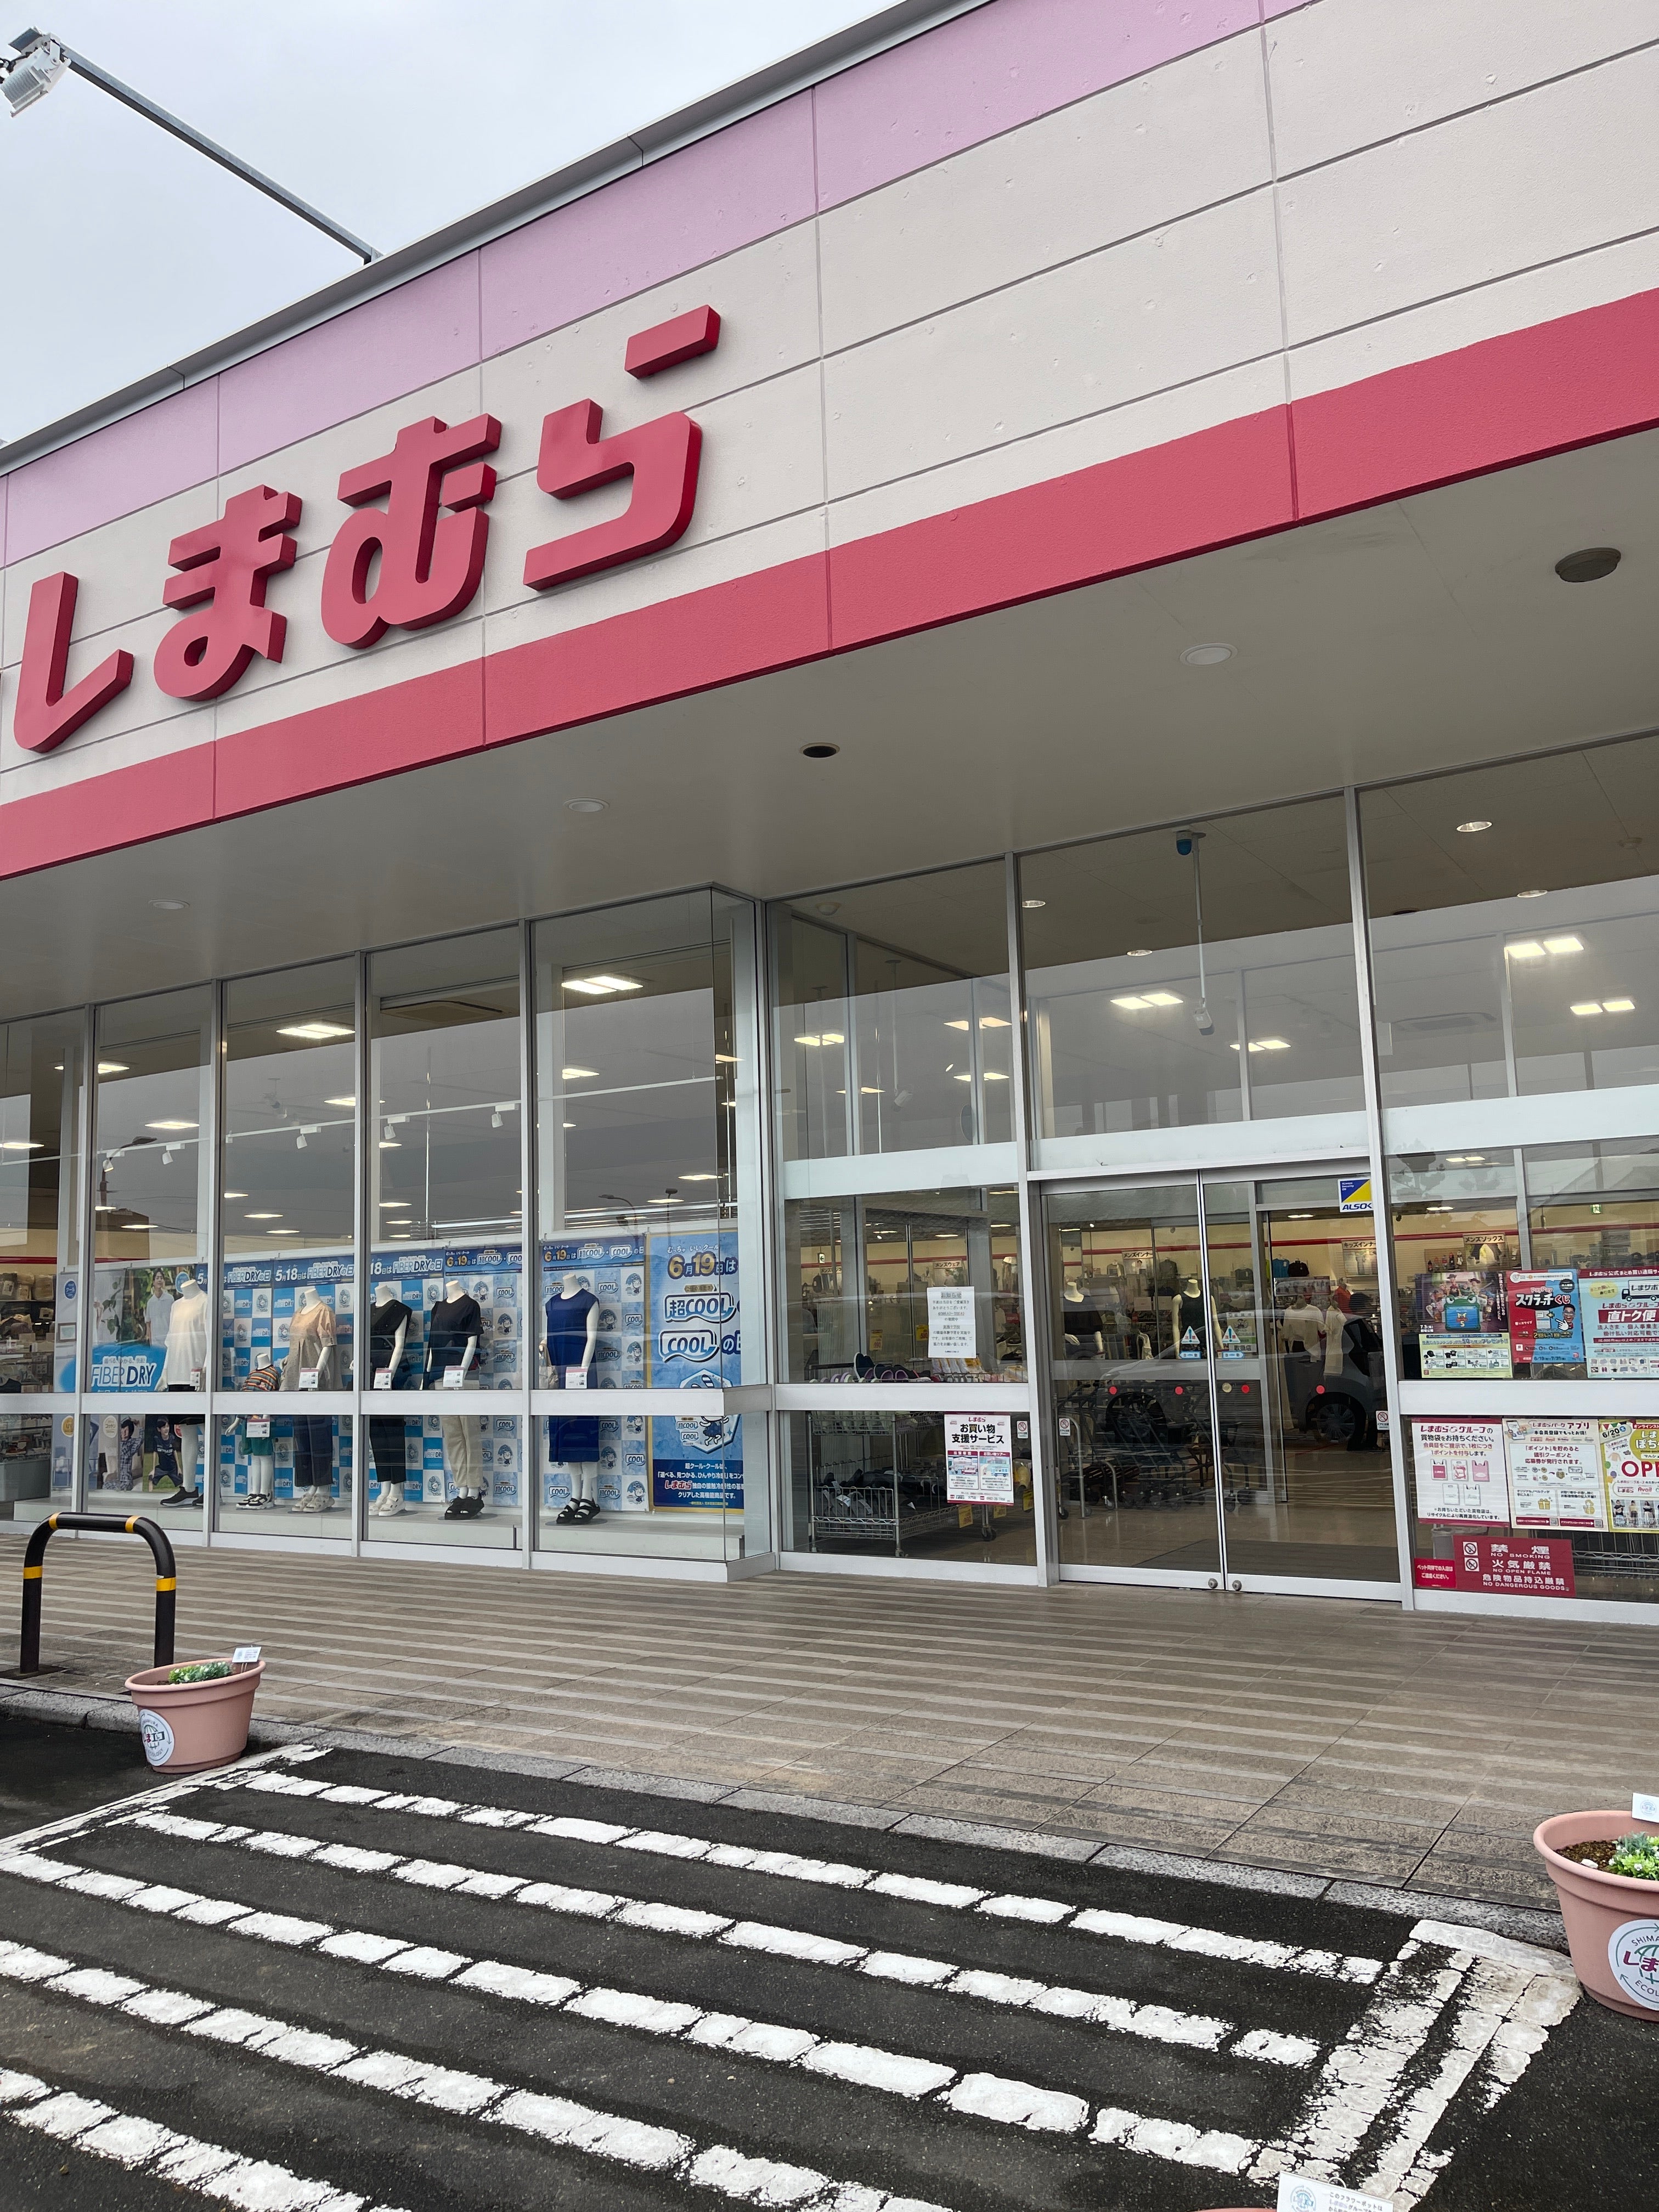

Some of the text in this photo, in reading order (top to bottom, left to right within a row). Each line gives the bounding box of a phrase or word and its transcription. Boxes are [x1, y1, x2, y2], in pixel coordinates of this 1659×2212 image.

[13, 304, 720, 753] しまむら
[446, 1255, 476, 1267] 6月19日は
[544, 1249, 576, 1262] 6月19日は
[668, 1252, 736, 1278] 6月19日は
[1516, 1294, 1571, 1306] スクラッチくじ
[669, 1297, 727, 1317] 超COOL
[1607, 1310, 1657, 1323] 直トク便
[668, 1336, 708, 1353] COOL
[960, 1424, 995, 1434] お買い物
[1567, 1421, 1590, 1430] アプリ
[1602, 1428, 1620, 1437] 6/20
[1641, 1430, 1657, 1438] しま
[952, 1434, 1005, 1444] 支援サービス
[1635, 1438, 1659, 1449] ぽち
[1492, 1559, 1551, 1571] 火気厳禁
[1482, 1573, 1565, 1585] 危険物品持込厳禁
[1329, 2192, 1383, 2211] このフラワーポットは
